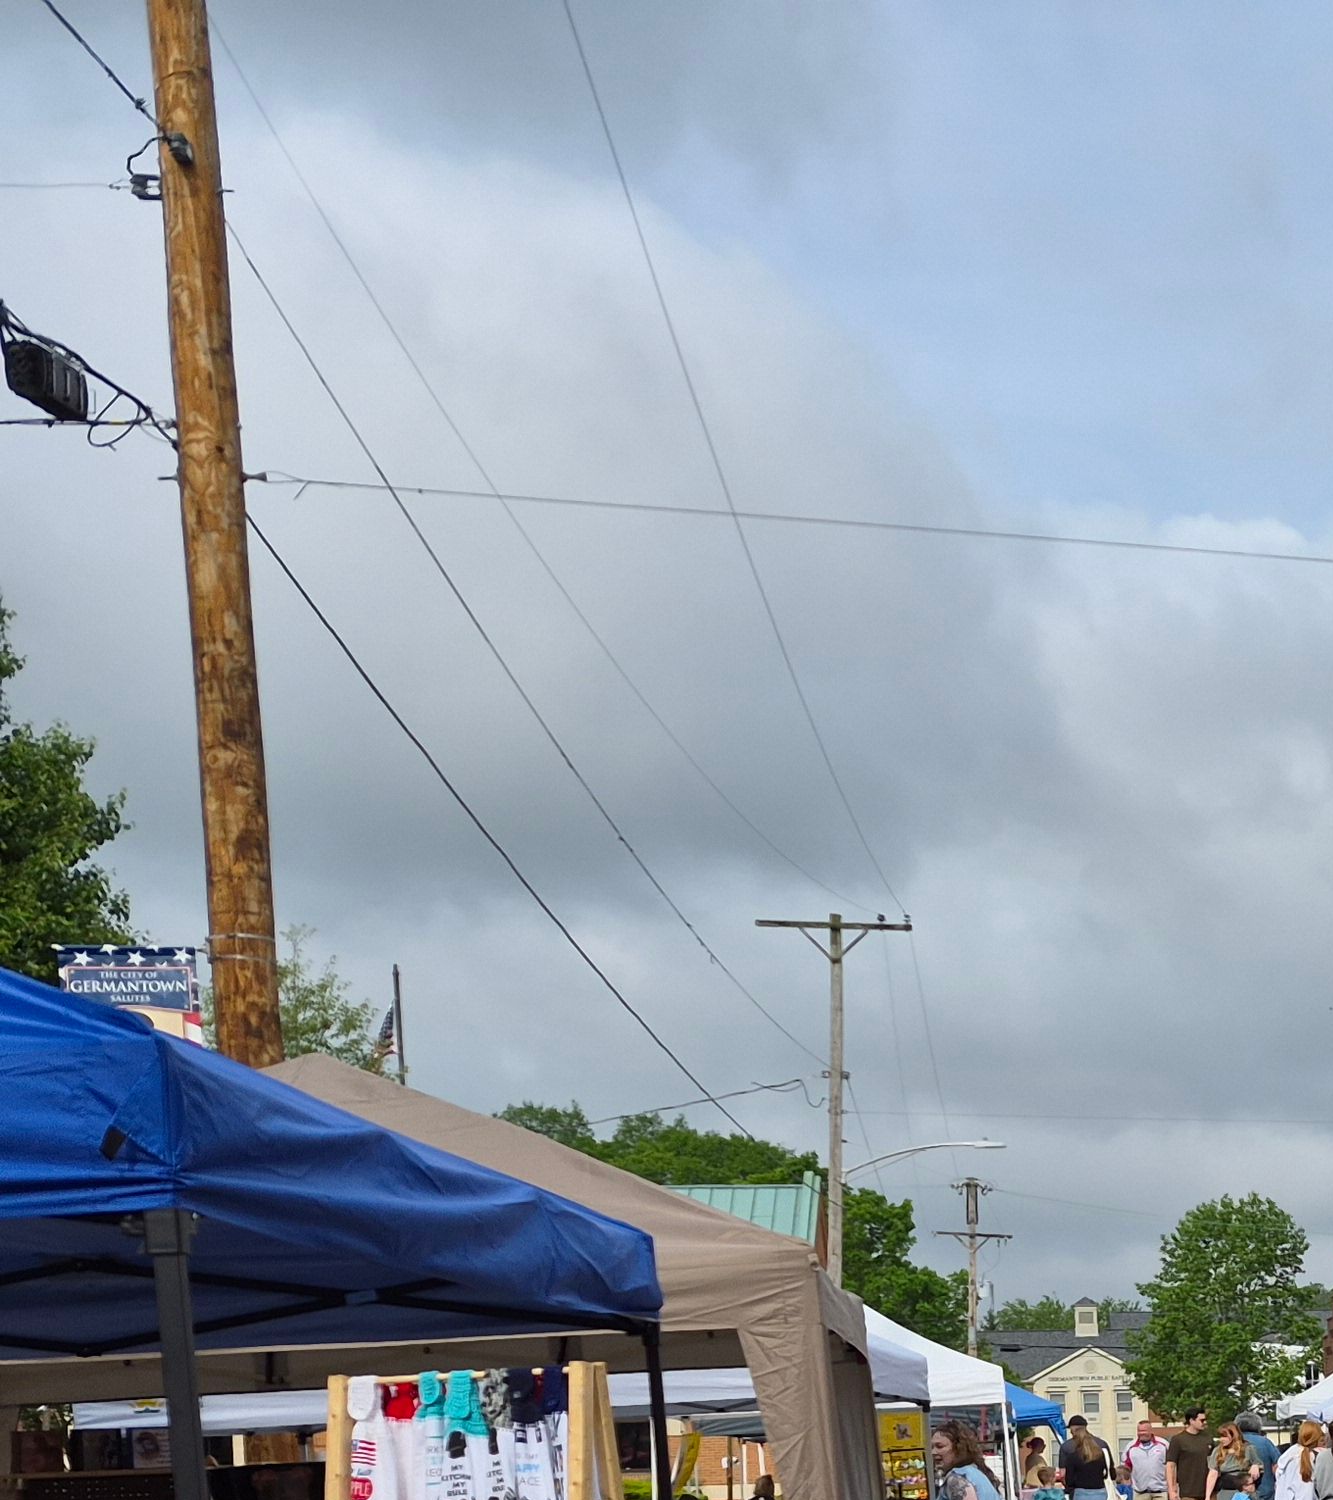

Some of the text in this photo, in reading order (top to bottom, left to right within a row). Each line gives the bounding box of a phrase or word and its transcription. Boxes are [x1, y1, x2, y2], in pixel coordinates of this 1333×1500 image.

[100, 970, 158, 979] THE CITY OF
[70, 979, 188, 993] GERMANTOWN
[109, 994, 151, 1002] SALUTES
